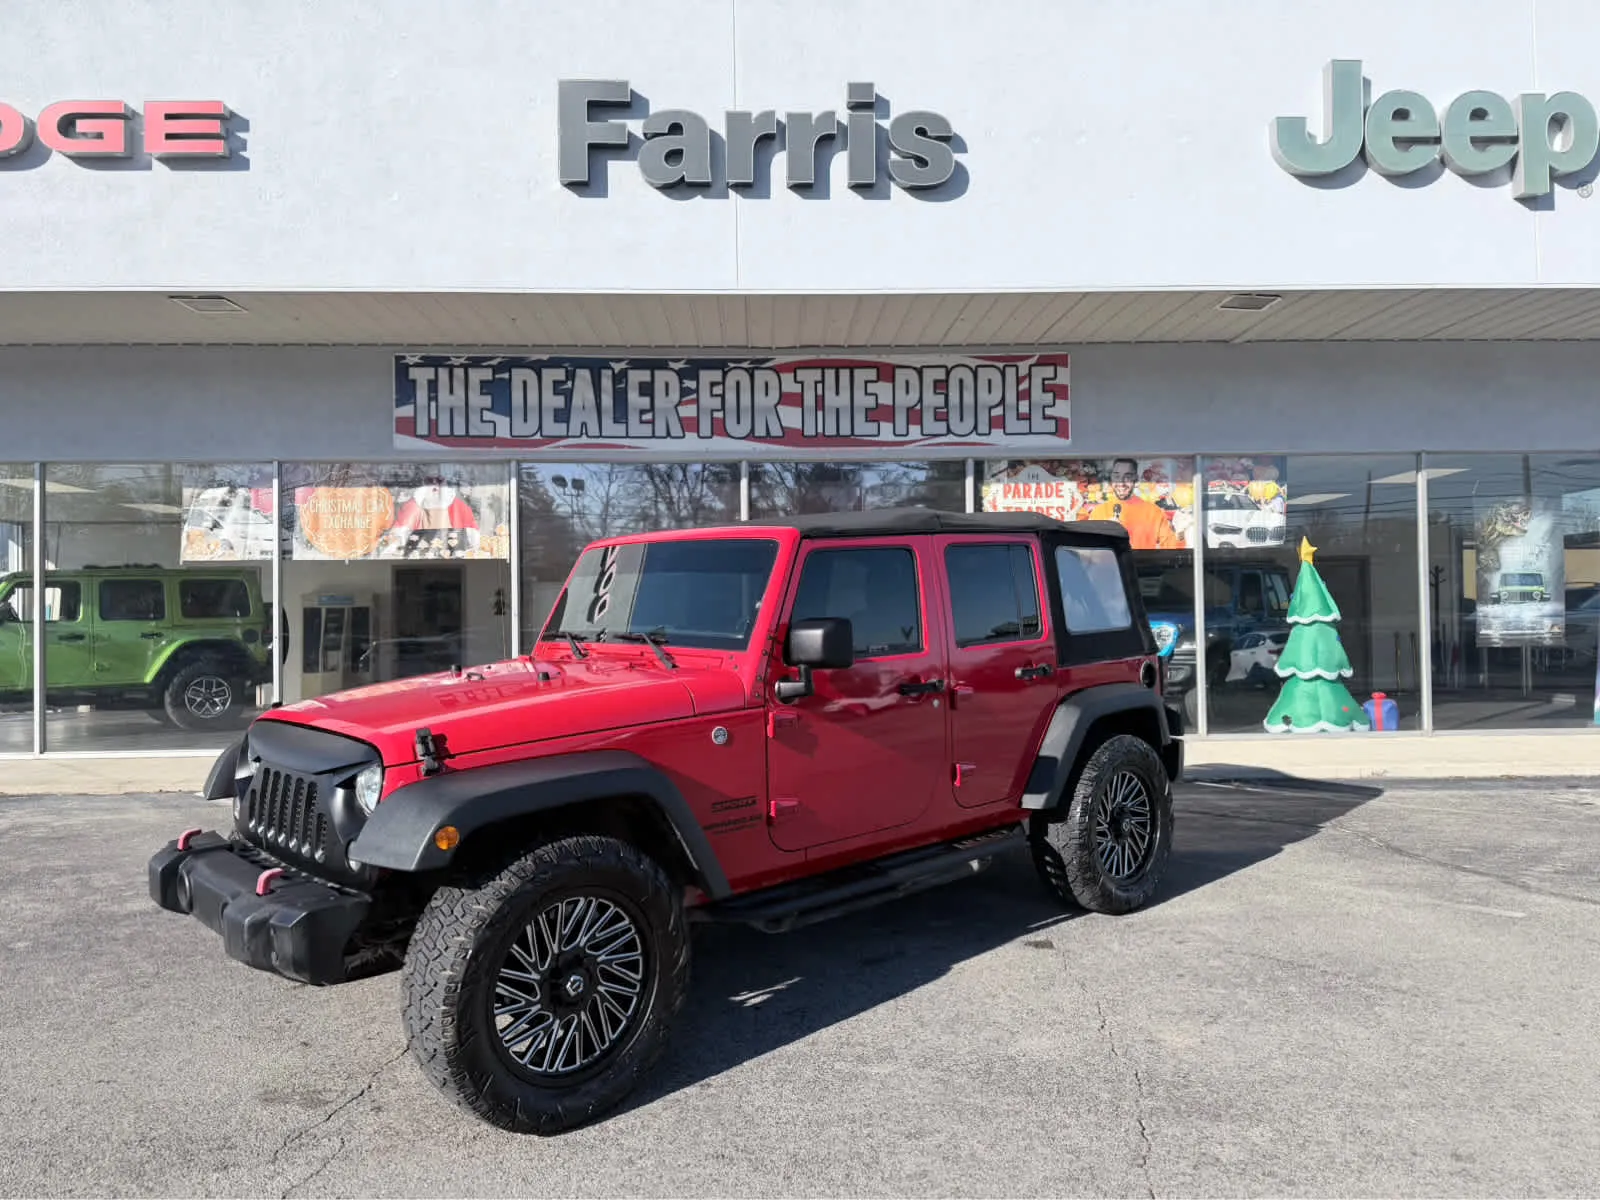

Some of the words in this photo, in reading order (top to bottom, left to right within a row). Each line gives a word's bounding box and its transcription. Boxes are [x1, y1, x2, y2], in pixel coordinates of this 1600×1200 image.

[0, 99, 231, 158] GE
[557, 78, 956, 190] Farris
[1268, 58, 1599, 201] Jeep
[407, 365, 496, 439] THE
[509, 365, 686, 440] DEALER
[697, 366, 784, 439] FOR
[794, 366, 881, 437] THE
[892, 364, 1057, 437] PEOPLE
[1002, 481, 1065, 500] PARADE
